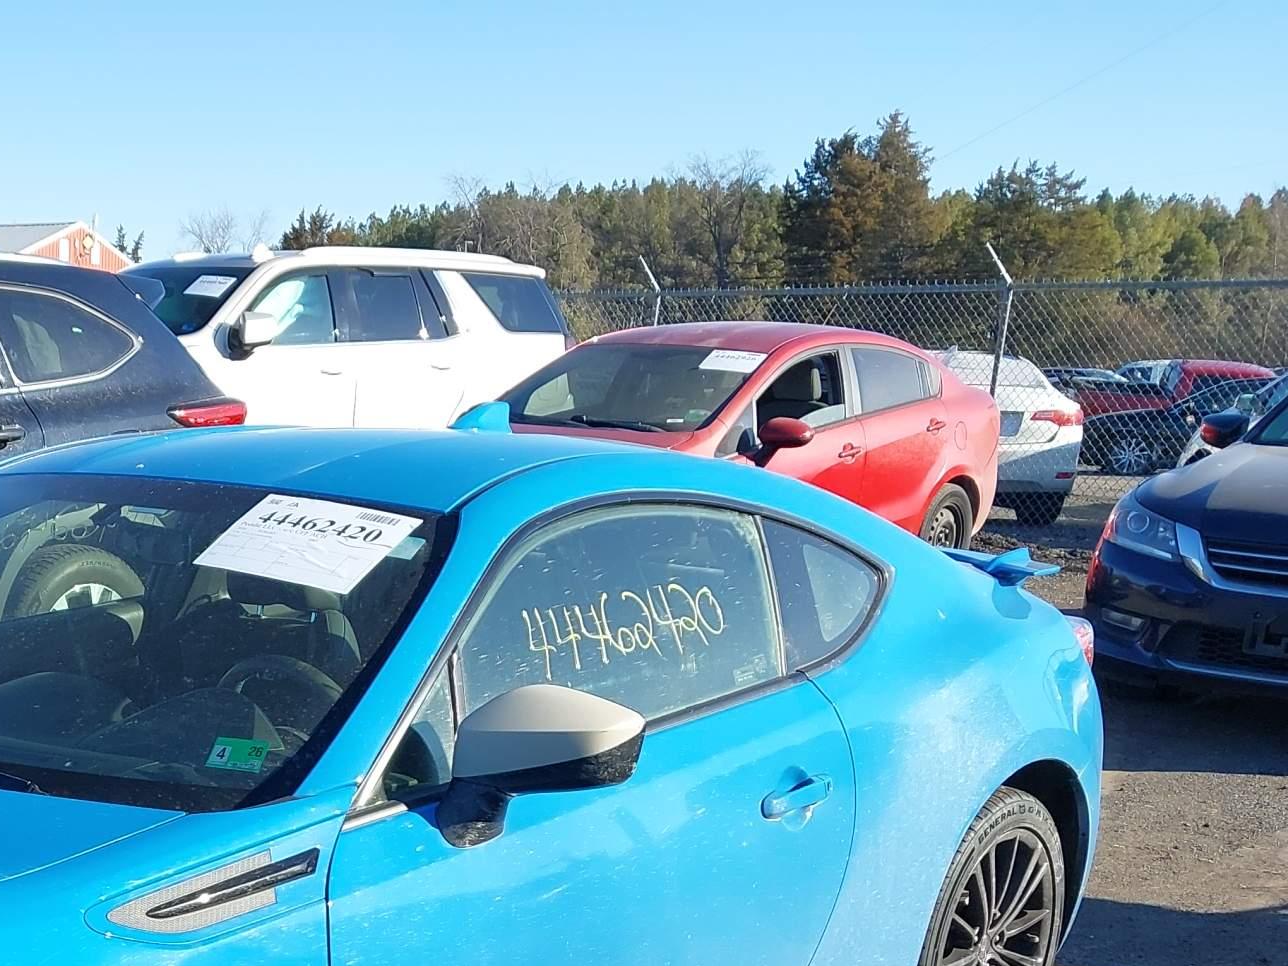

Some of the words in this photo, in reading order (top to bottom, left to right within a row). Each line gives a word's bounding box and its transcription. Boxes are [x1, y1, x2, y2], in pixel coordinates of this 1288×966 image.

[258, 511, 383, 543] 44462420
[522, 583, 724, 681] 44462420
[216, 746, 227, 760] 4
[247, 746, 264, 758] 26
[978, 807, 1017, 845] GENERAL
